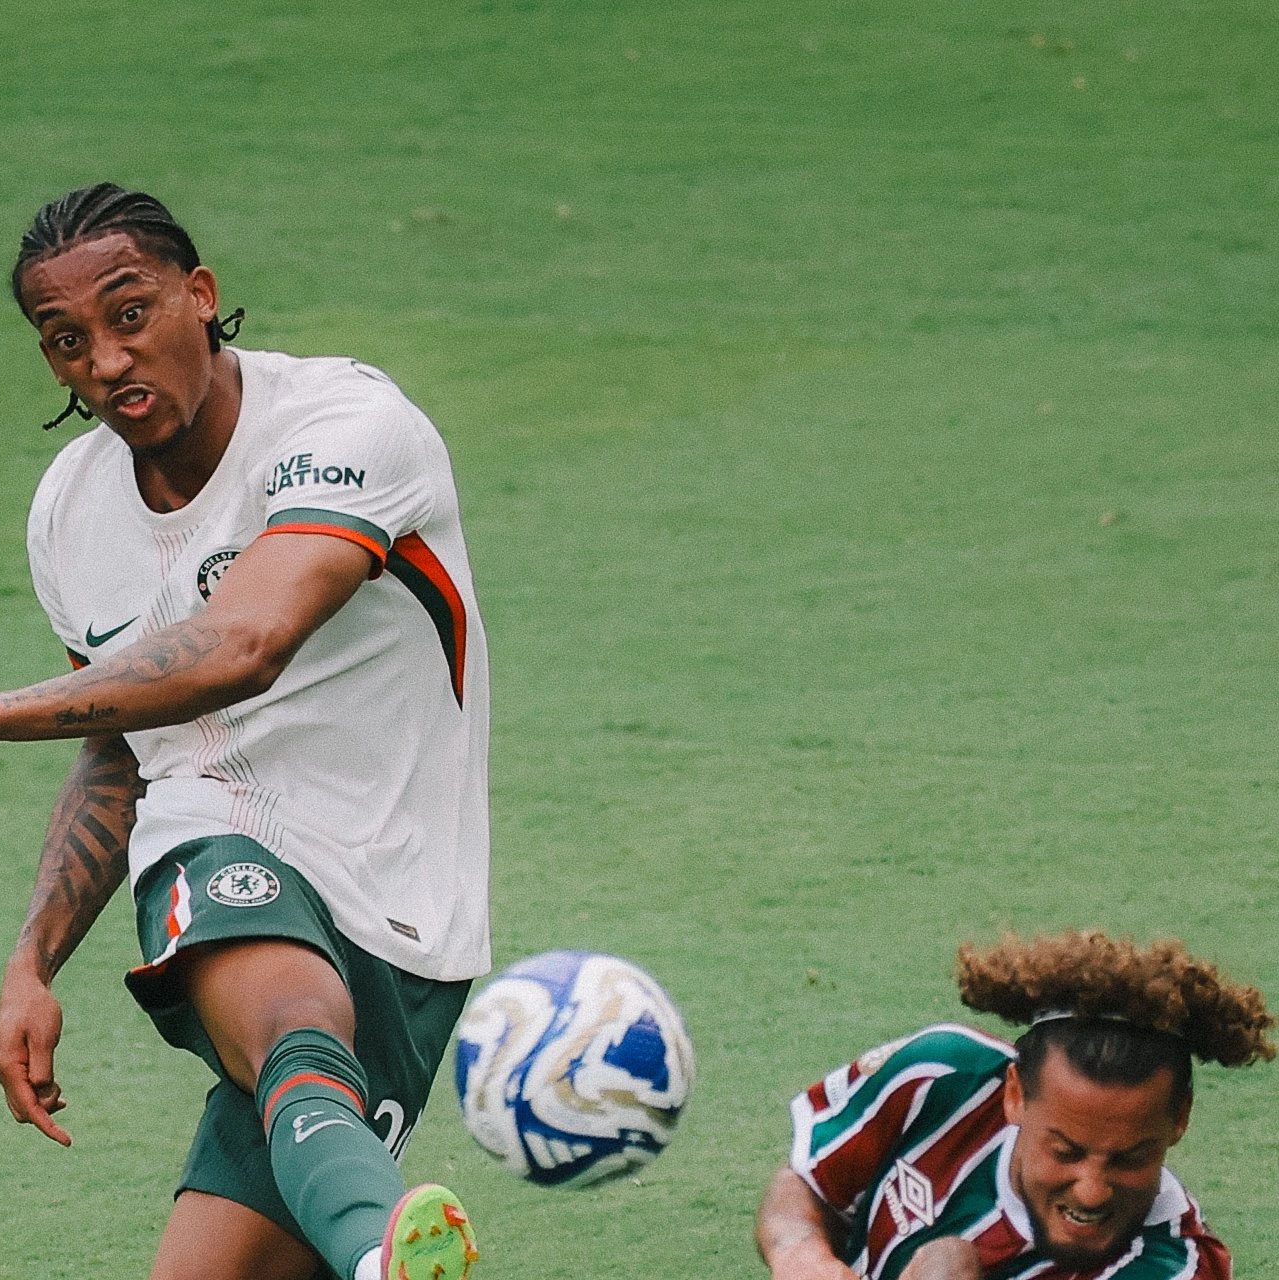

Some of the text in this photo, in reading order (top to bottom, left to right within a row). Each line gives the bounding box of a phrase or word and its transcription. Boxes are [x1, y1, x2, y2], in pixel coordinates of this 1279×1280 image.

[273, 453, 313, 479] IVE
[199, 551, 235, 575] CHELSE
[373, 1098, 413, 1158] 2
